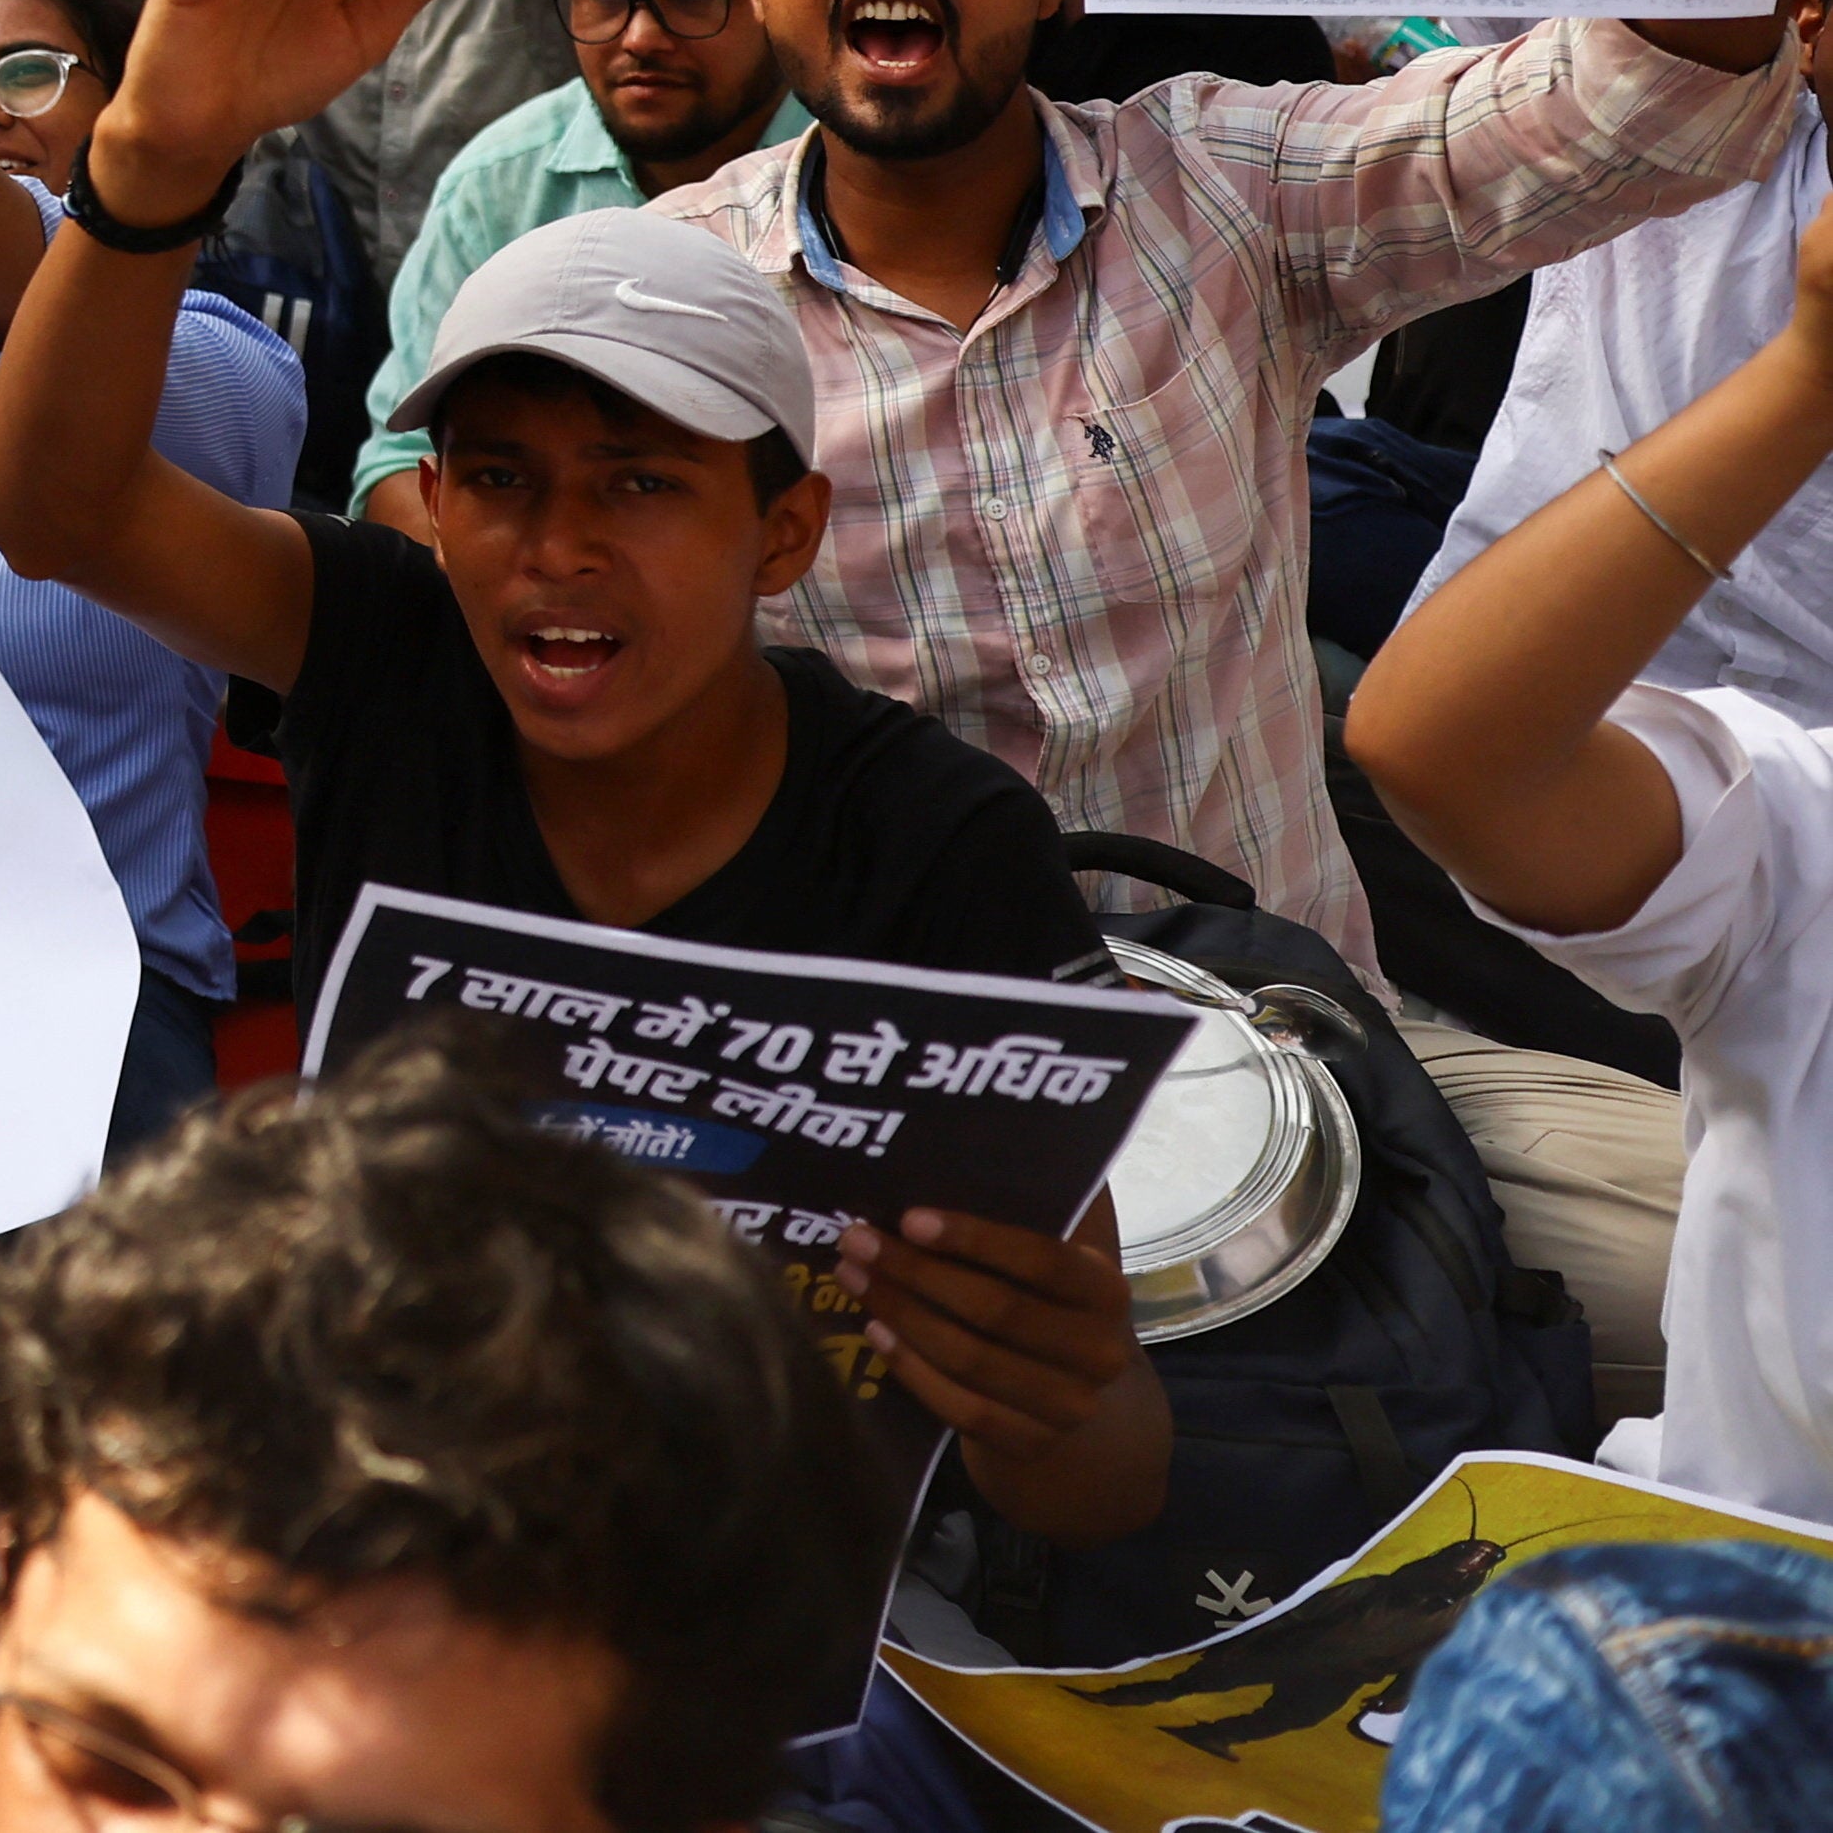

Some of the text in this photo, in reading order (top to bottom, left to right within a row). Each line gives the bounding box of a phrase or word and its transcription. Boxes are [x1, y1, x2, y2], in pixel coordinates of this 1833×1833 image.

[406, 955, 1126, 1107] 7 साल में 70 से अधिक
[564, 1040, 905, 1158] पेपर लीक!
